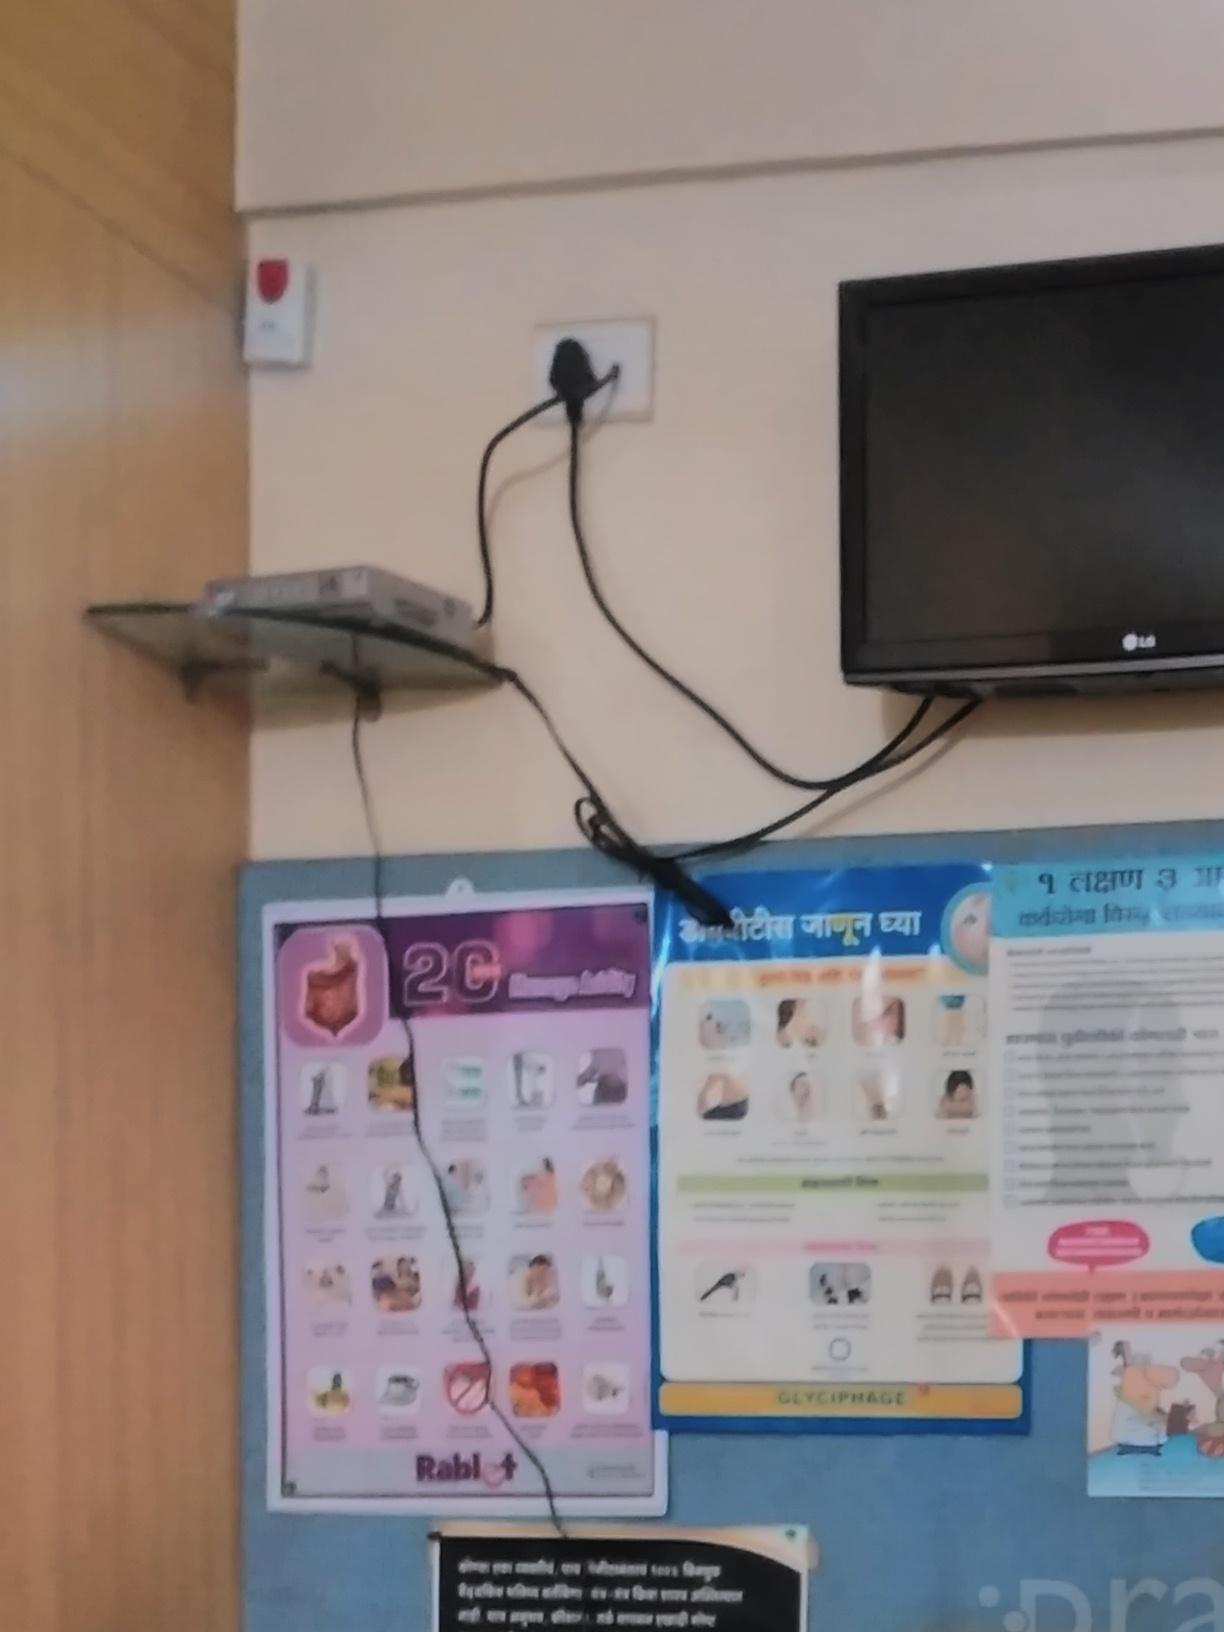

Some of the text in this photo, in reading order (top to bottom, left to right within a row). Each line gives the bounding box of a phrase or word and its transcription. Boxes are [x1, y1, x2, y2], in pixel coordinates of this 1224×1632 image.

[1069, 867, 1144, 894] लक्षण
[801, 912, 874, 946] जाणून
[879, 911, 922, 935] घ्या
[777, 1390, 905, 1406] GLYCIPHAGE
